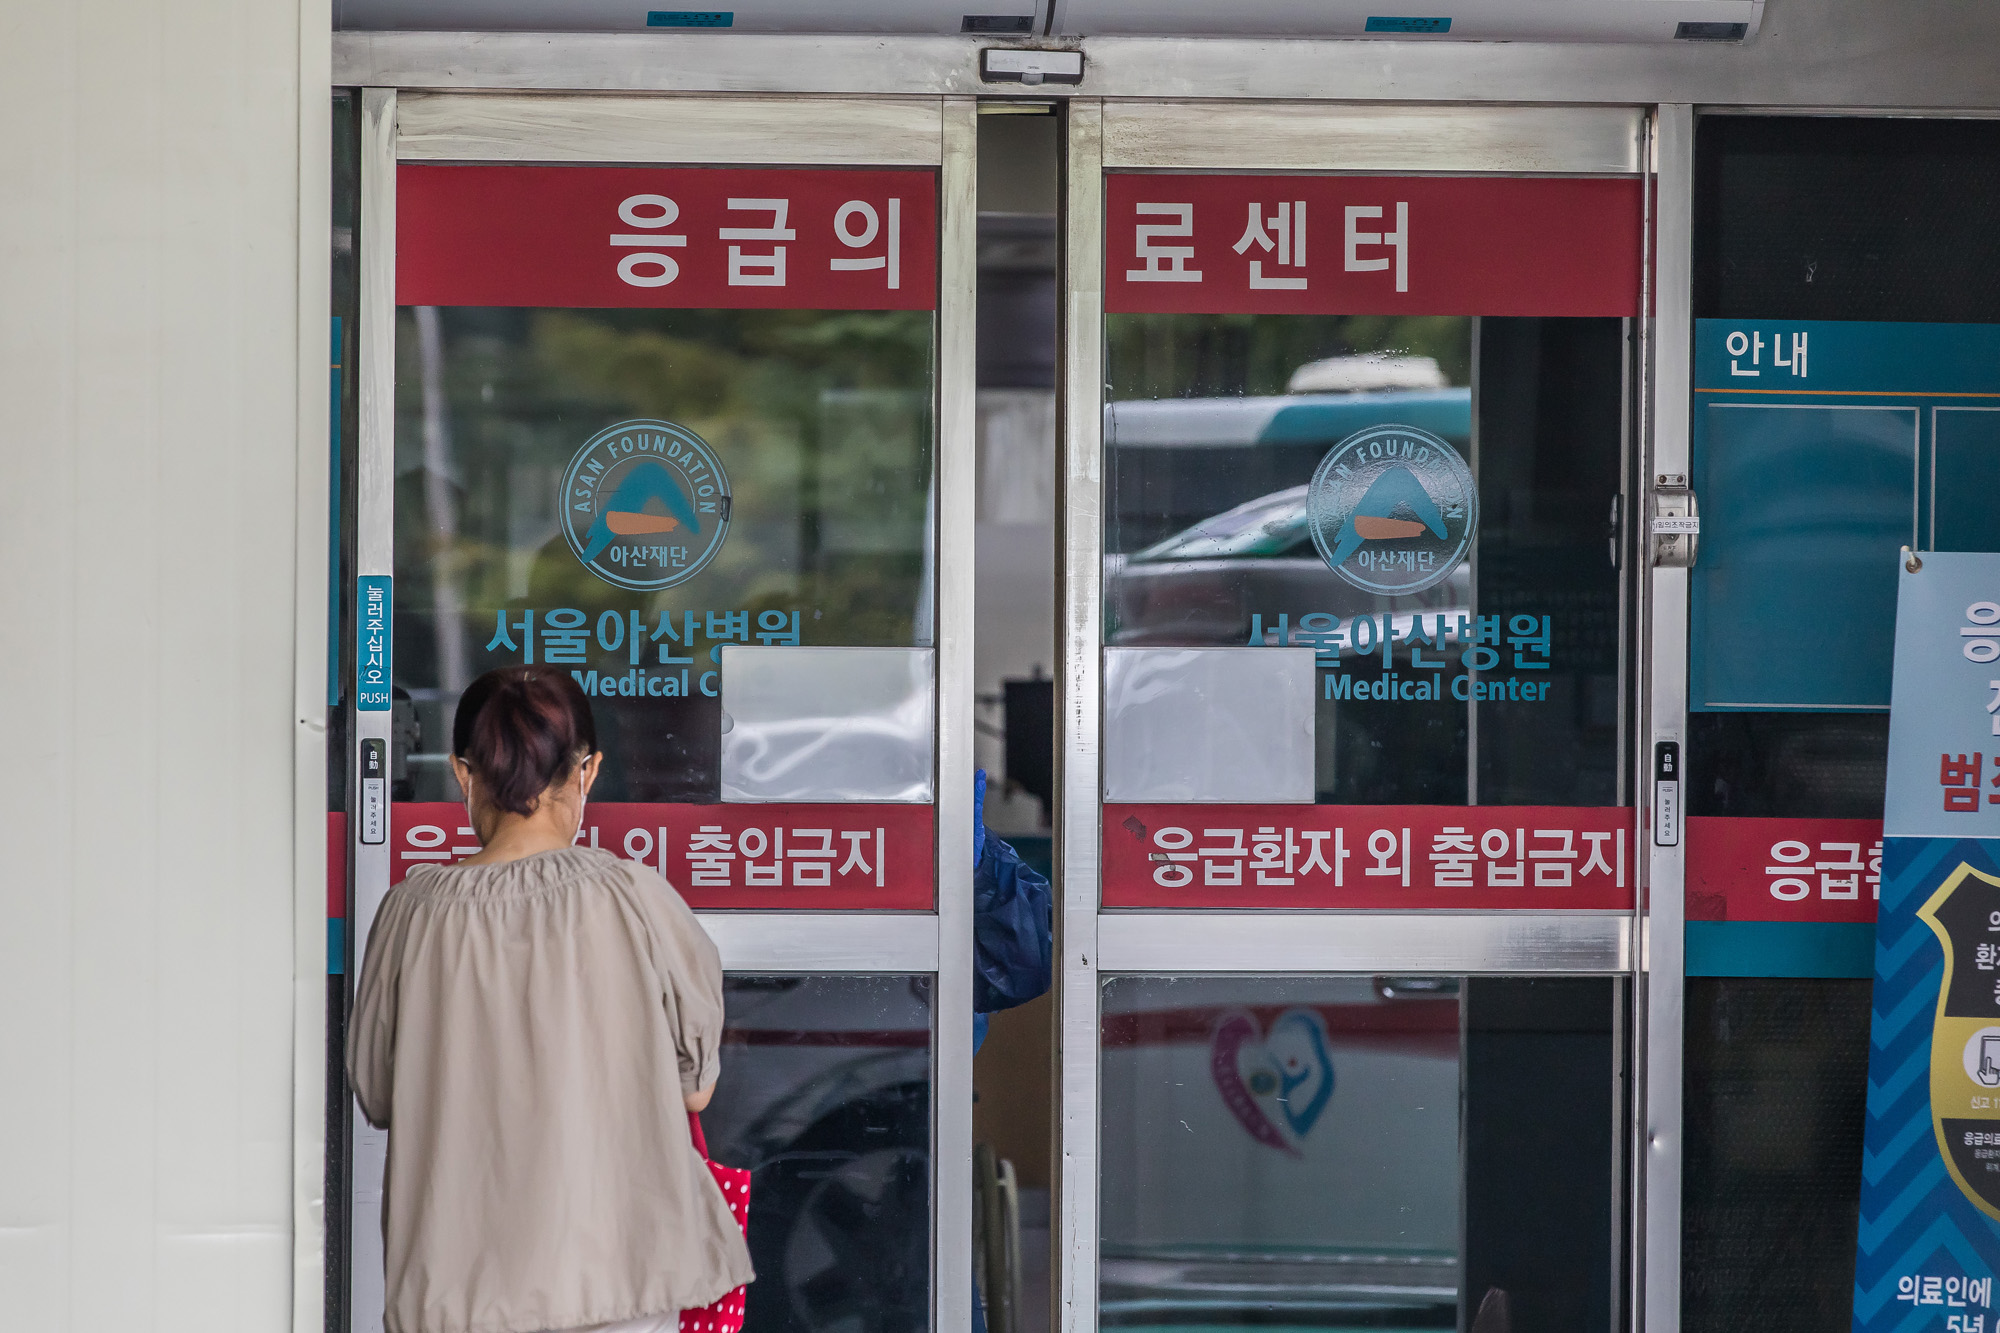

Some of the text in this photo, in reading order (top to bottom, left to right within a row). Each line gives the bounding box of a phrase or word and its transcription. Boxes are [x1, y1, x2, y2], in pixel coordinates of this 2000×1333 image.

[1726, 331, 1808, 378] 안내
[574, 433, 717, 514] ASAN FOUNDATION
[610, 545, 689, 568] 아산재단
[1358, 550, 1436, 572] 아산재단
[365, 584, 385, 685] 눌러주십시오
[360, 692, 389, 704] PUSH
[571, 669, 689, 697] Medical
[1324, 672, 1551, 701] Medical Center
[686, 825, 885, 888] 출입금지
[1148, 826, 1626, 888] 응급환자 외 출입금지
[1975, 943, 2000, 971] 환
[1896, 1274, 1992, 1309] 의료인에
